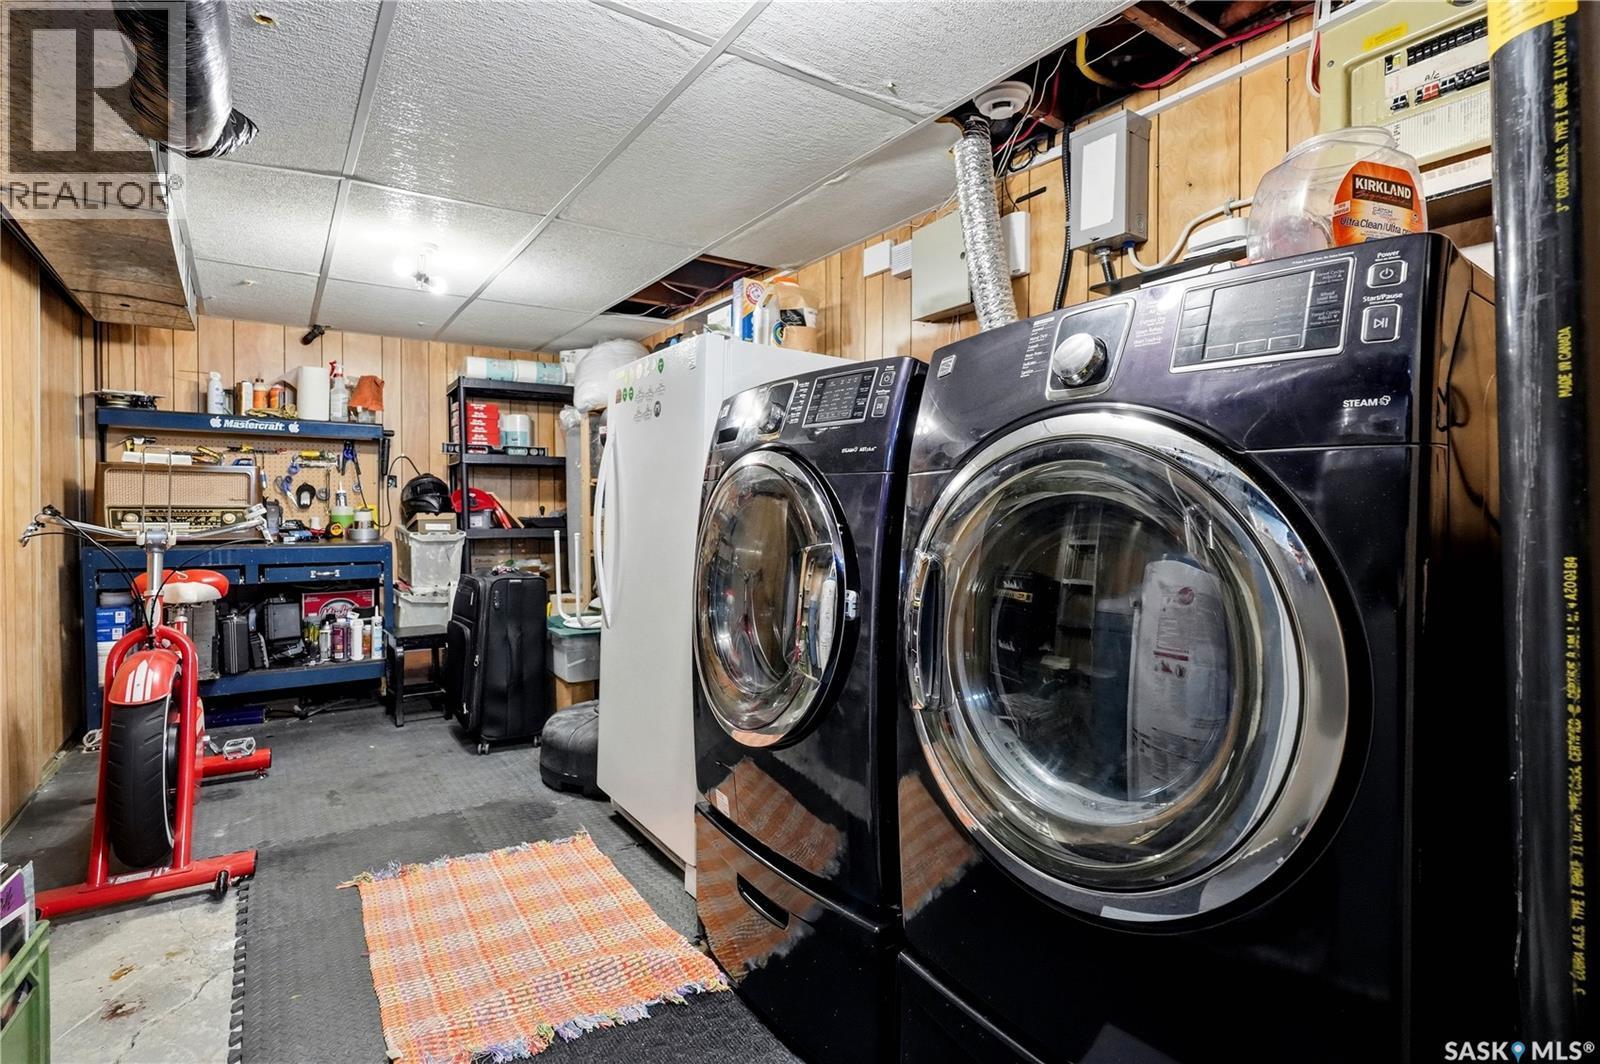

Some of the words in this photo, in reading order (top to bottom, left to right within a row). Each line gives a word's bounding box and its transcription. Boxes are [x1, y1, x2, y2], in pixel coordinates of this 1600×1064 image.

[1553, 119, 1569, 143] TYPE
[1355, 177, 1412, 200] KIRKLAND
[1554, 169, 1570, 199] COBRA
[1377, 250, 1400, 259] Power
[1362, 292, 1404, 303] Start/Pause
[1556, 326, 1572, 361] CANADA
[1557, 361, 1572, 371] IN
[1557, 373, 1573, 398] MADE
[1343, 398, 1378, 408] STEAM
[223, 419, 285, 432] Mastercraft
